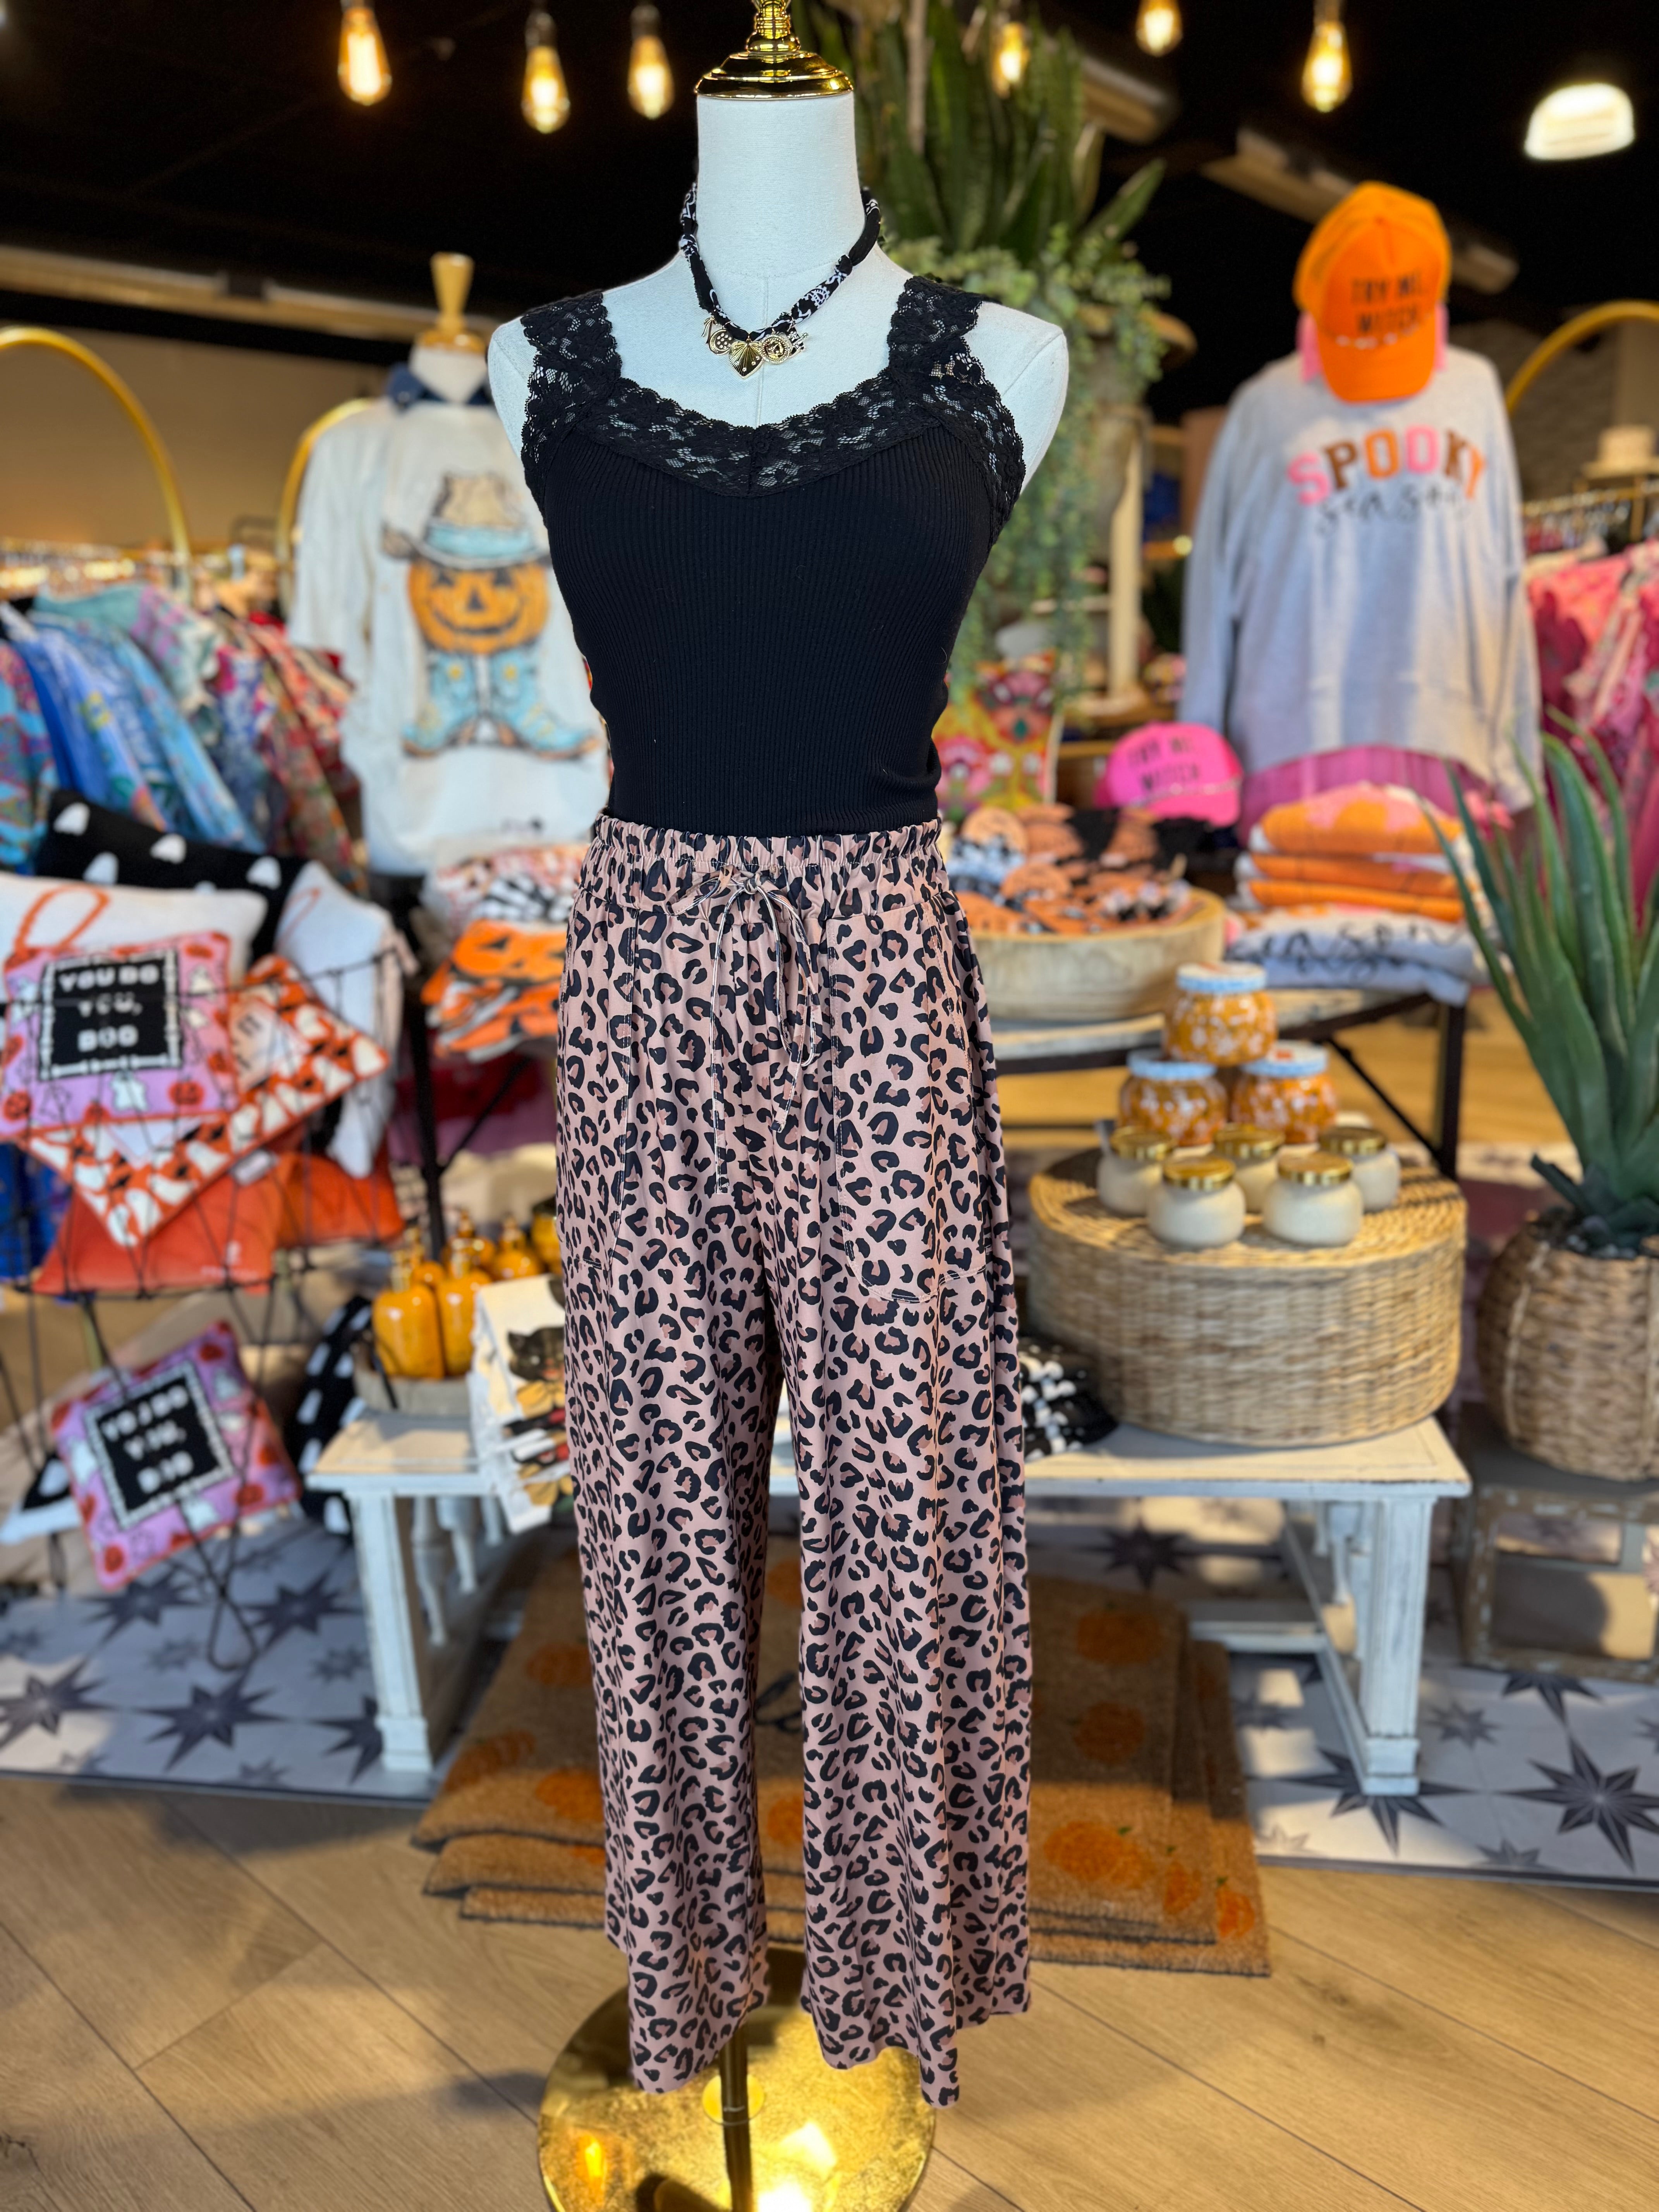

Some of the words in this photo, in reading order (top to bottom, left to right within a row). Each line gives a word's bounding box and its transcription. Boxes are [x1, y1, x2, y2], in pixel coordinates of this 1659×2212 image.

[1286, 423, 1486, 507] SPOOKY
[59, 967, 116, 993] YOU
[117, 963, 160, 986] DO
[77, 1024, 139, 1053] BOO
